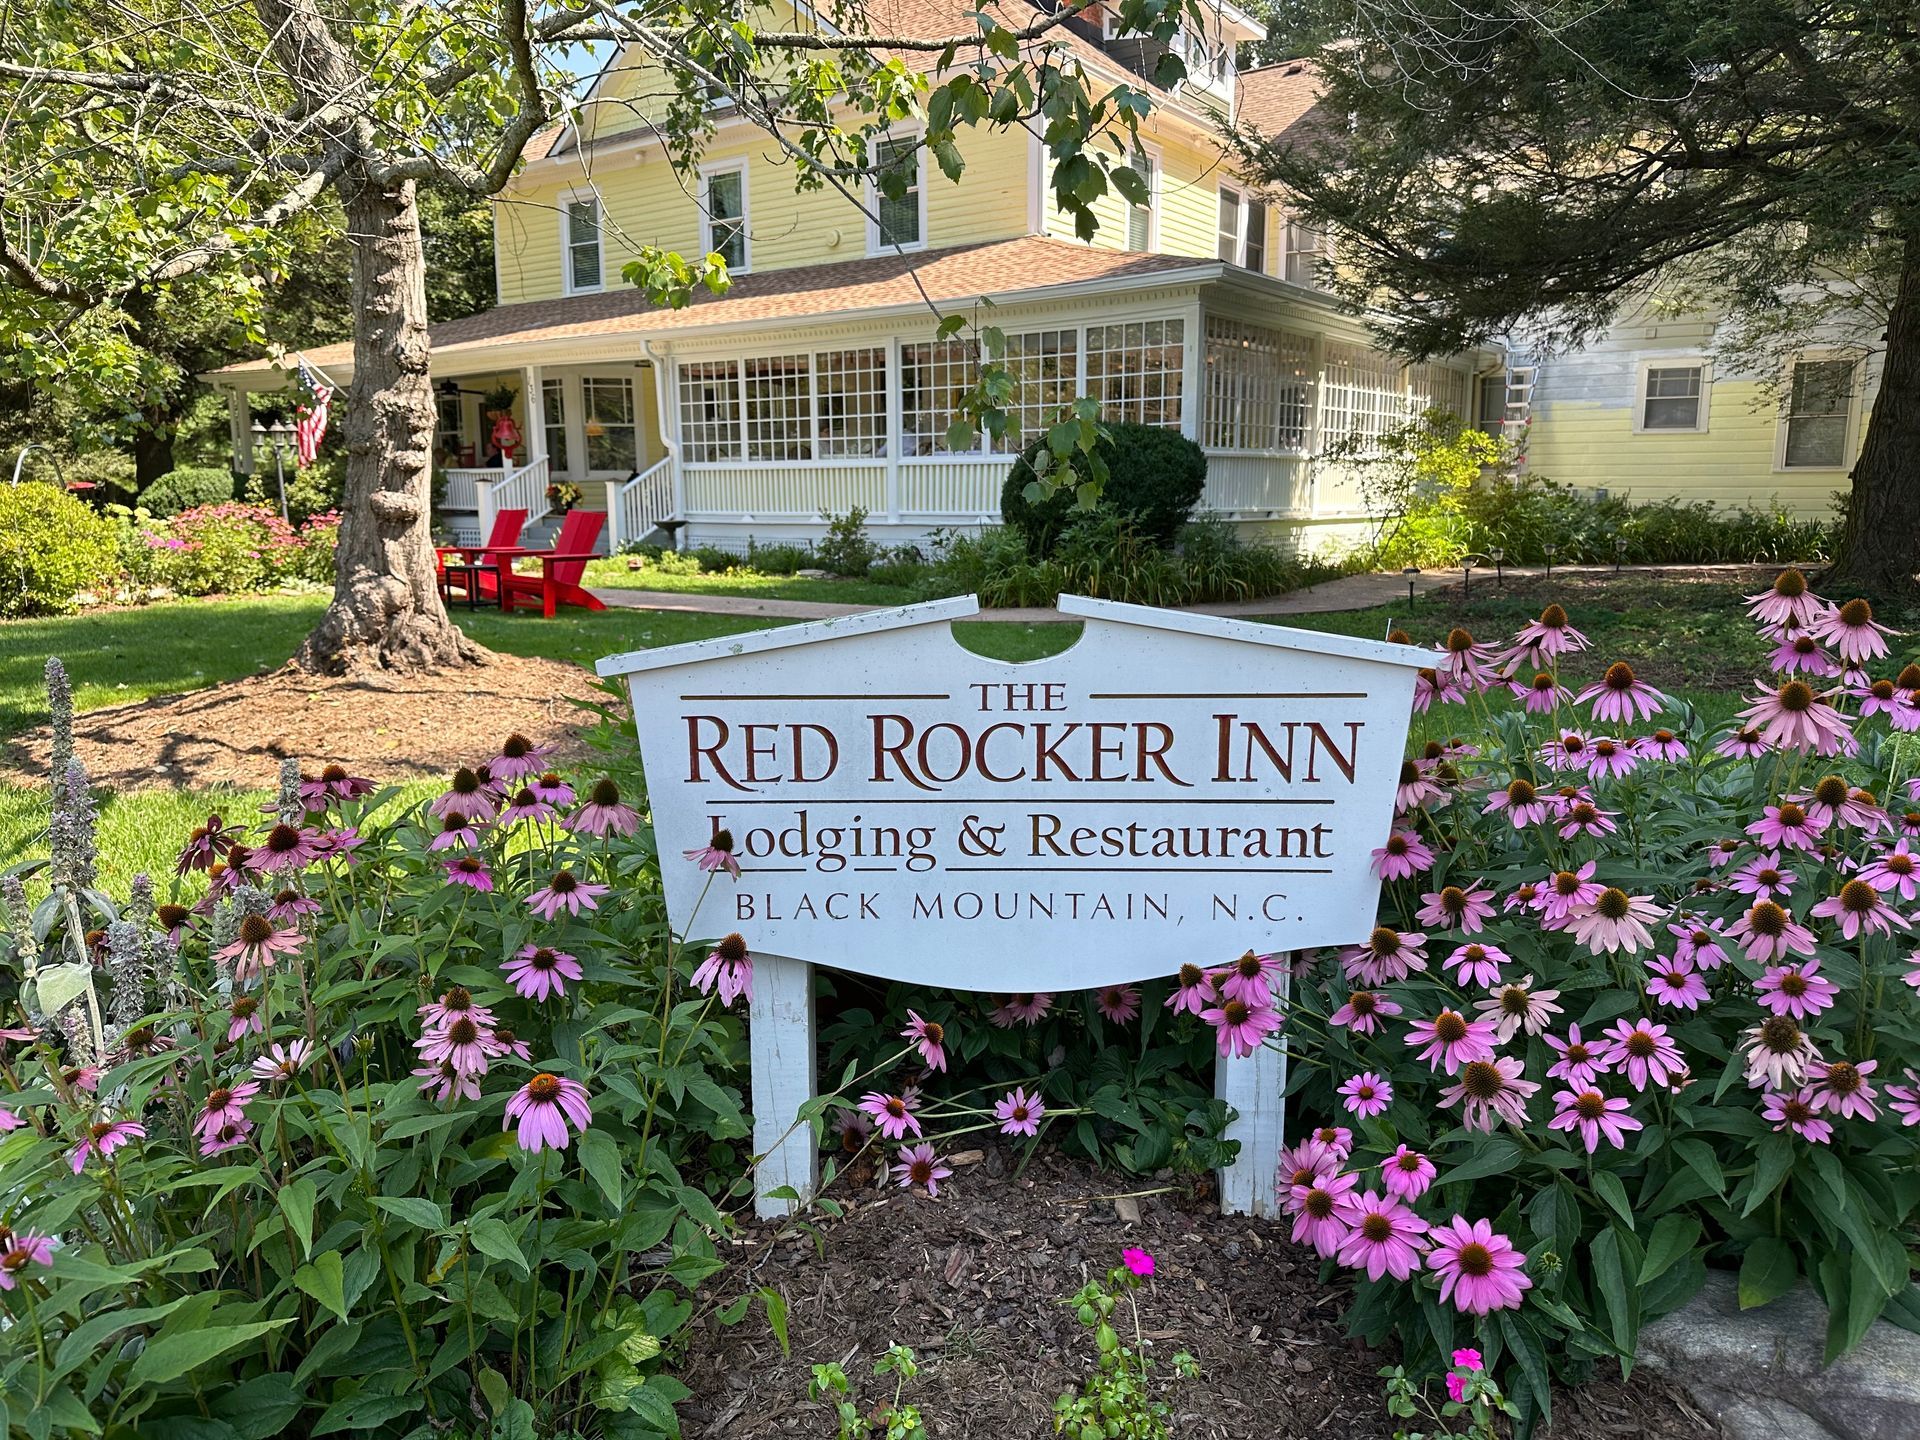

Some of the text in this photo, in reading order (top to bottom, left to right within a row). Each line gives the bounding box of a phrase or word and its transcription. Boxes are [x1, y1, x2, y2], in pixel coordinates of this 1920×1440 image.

[968, 683, 1068, 712] THE
[680, 713, 1366, 793] RED ROCKER INN
[957, 814, 1007, 857] &
[1026, 813, 1335, 859] Restaurant
[736, 891, 1303, 927] BLACK MOUNTAIN, N.C.
